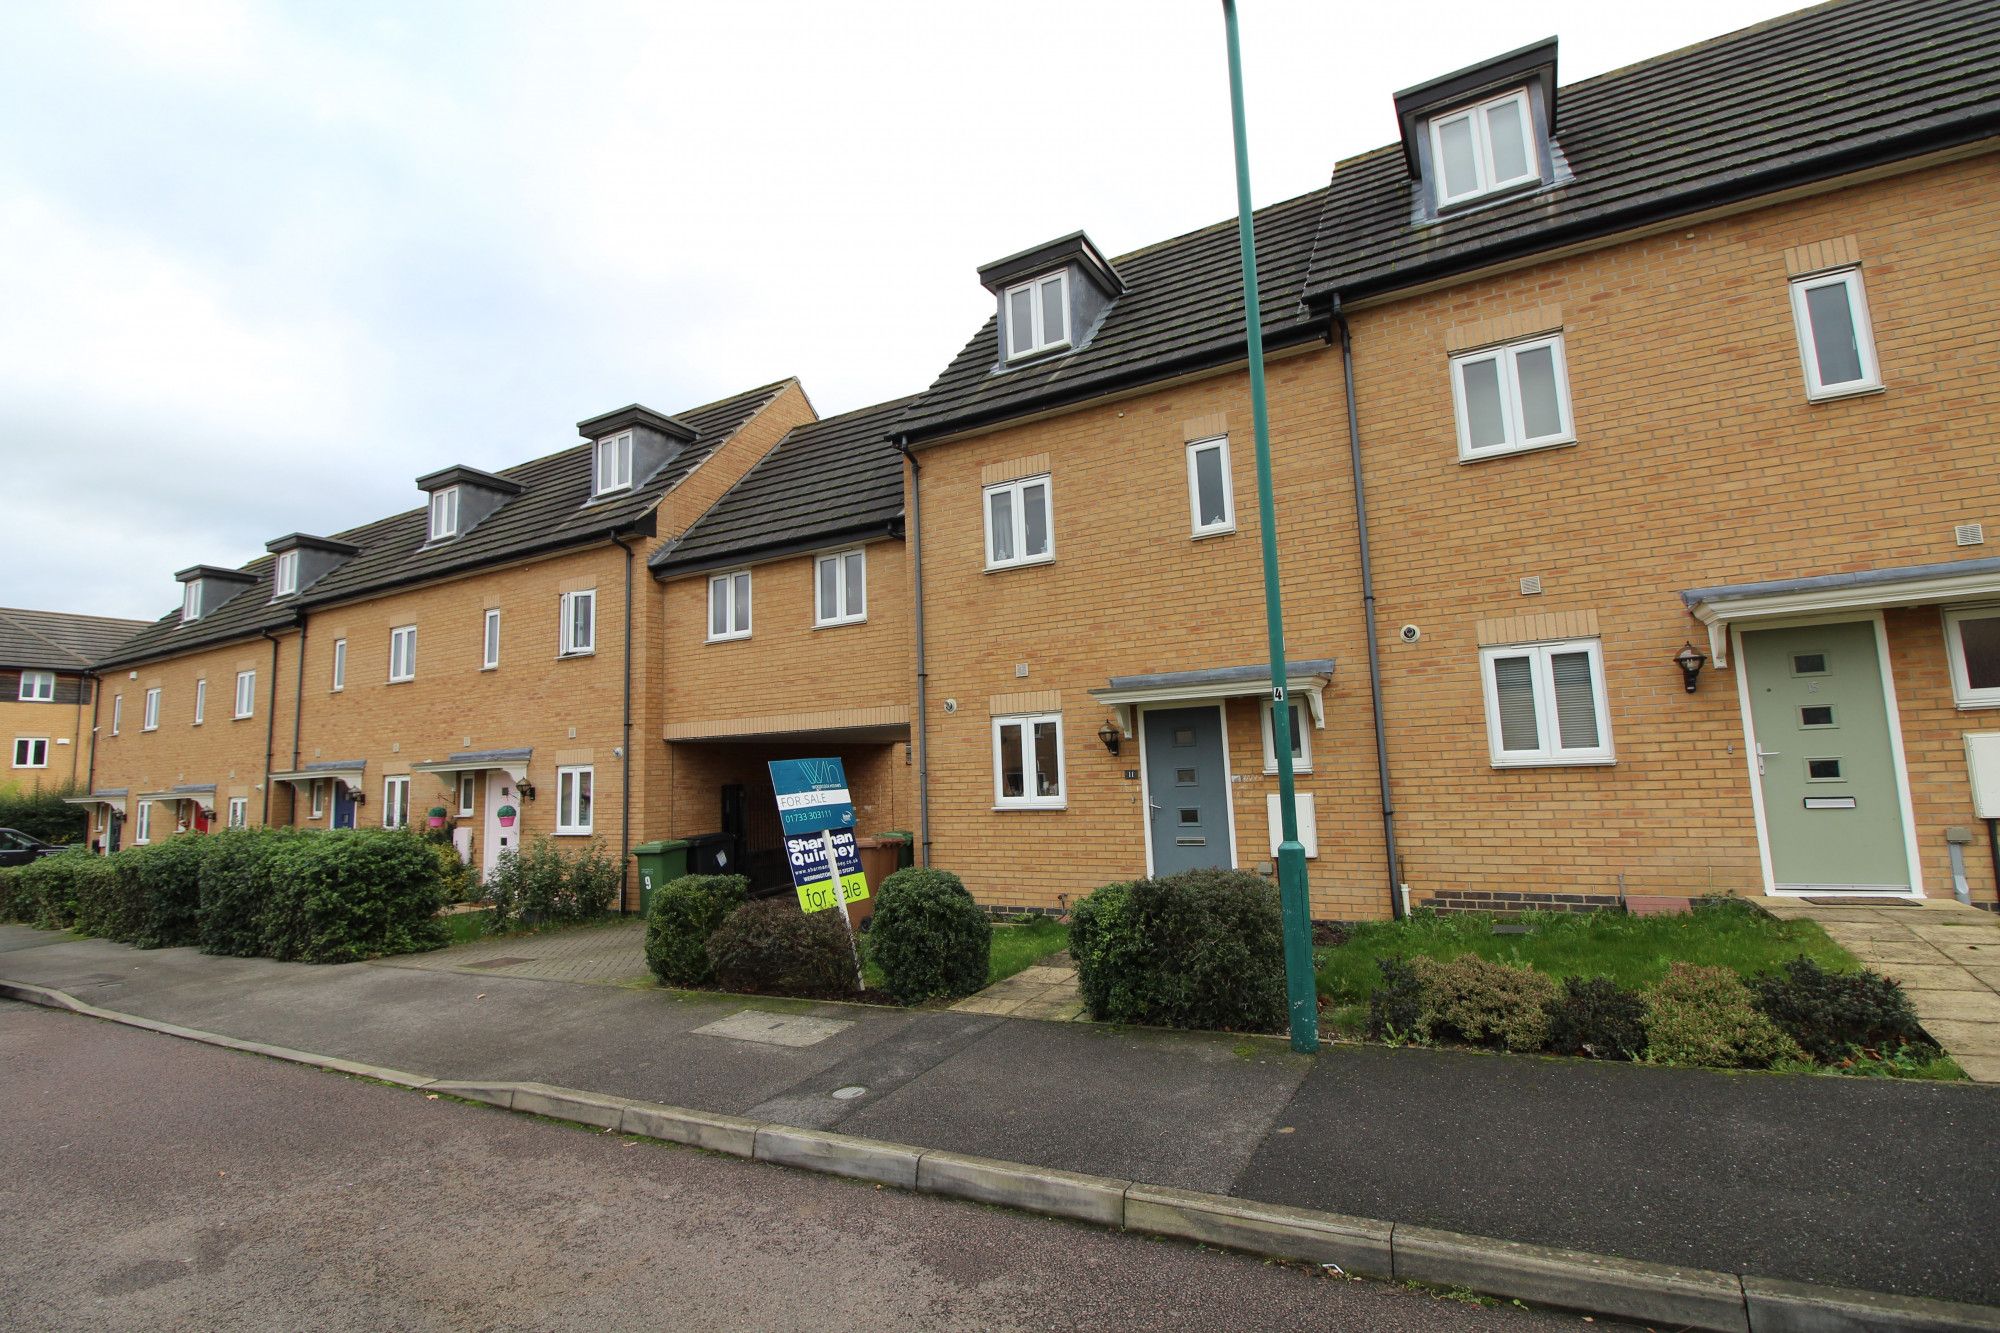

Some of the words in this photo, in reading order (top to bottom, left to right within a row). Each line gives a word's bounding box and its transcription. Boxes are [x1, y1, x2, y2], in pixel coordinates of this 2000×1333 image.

[1275, 687, 1282, 700] 4
[780, 796, 802, 808] FOR
[805, 793, 827, 805] SALE
[785, 812, 808, 823] 01733
[808, 810, 832, 820] 303111
[645, 876, 652, 890] 9
[806, 888, 826, 908] for
